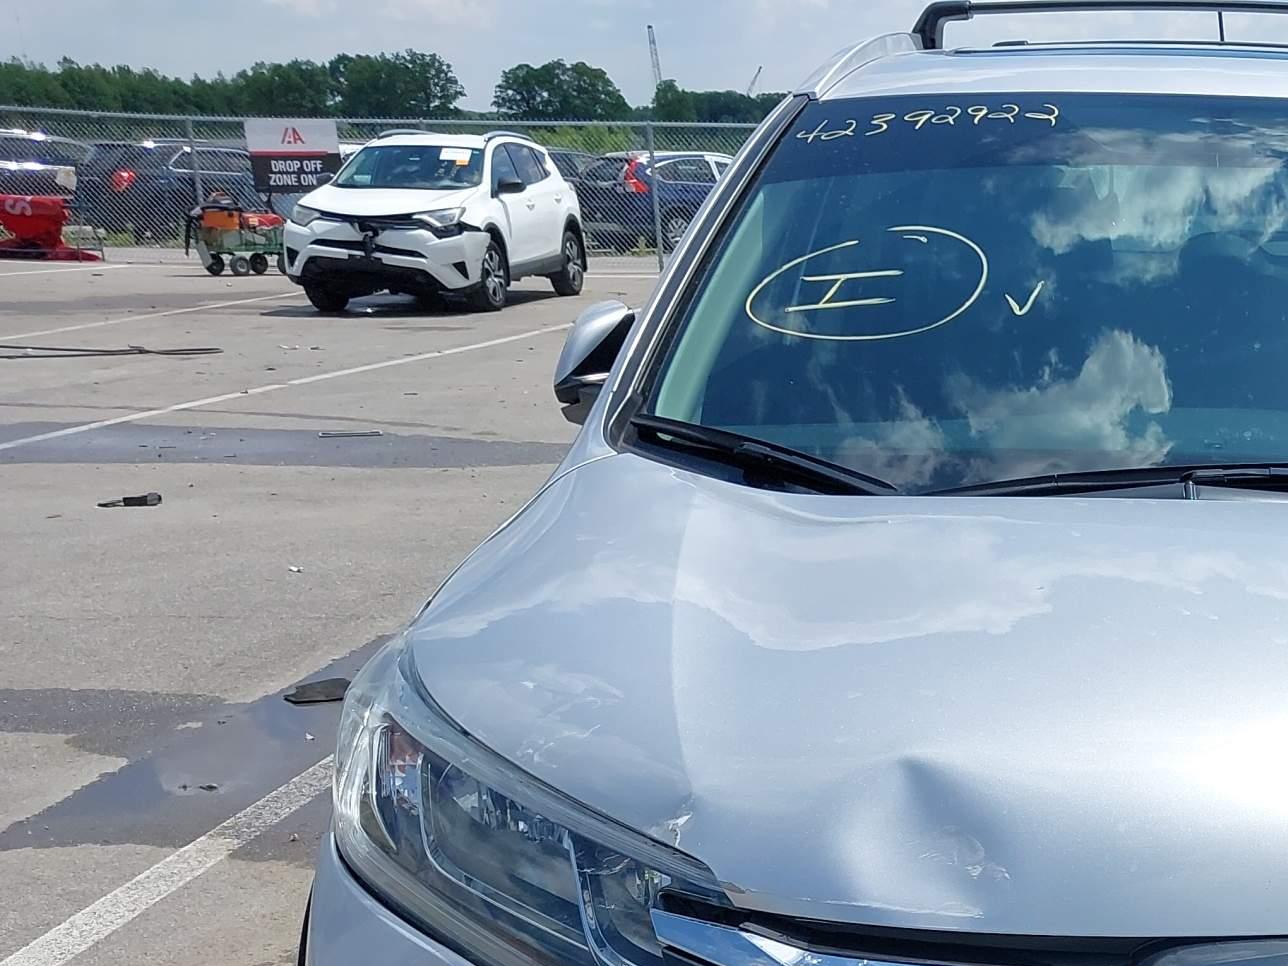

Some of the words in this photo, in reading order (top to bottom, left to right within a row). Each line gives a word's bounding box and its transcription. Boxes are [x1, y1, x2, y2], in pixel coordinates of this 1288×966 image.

[796, 104, 1059, 144] 42392922
[271, 160, 300, 172] DROP
[303, 160, 323, 172] OFF
[269, 174, 299, 186] ZONE
[301, 174, 317, 186] ON
